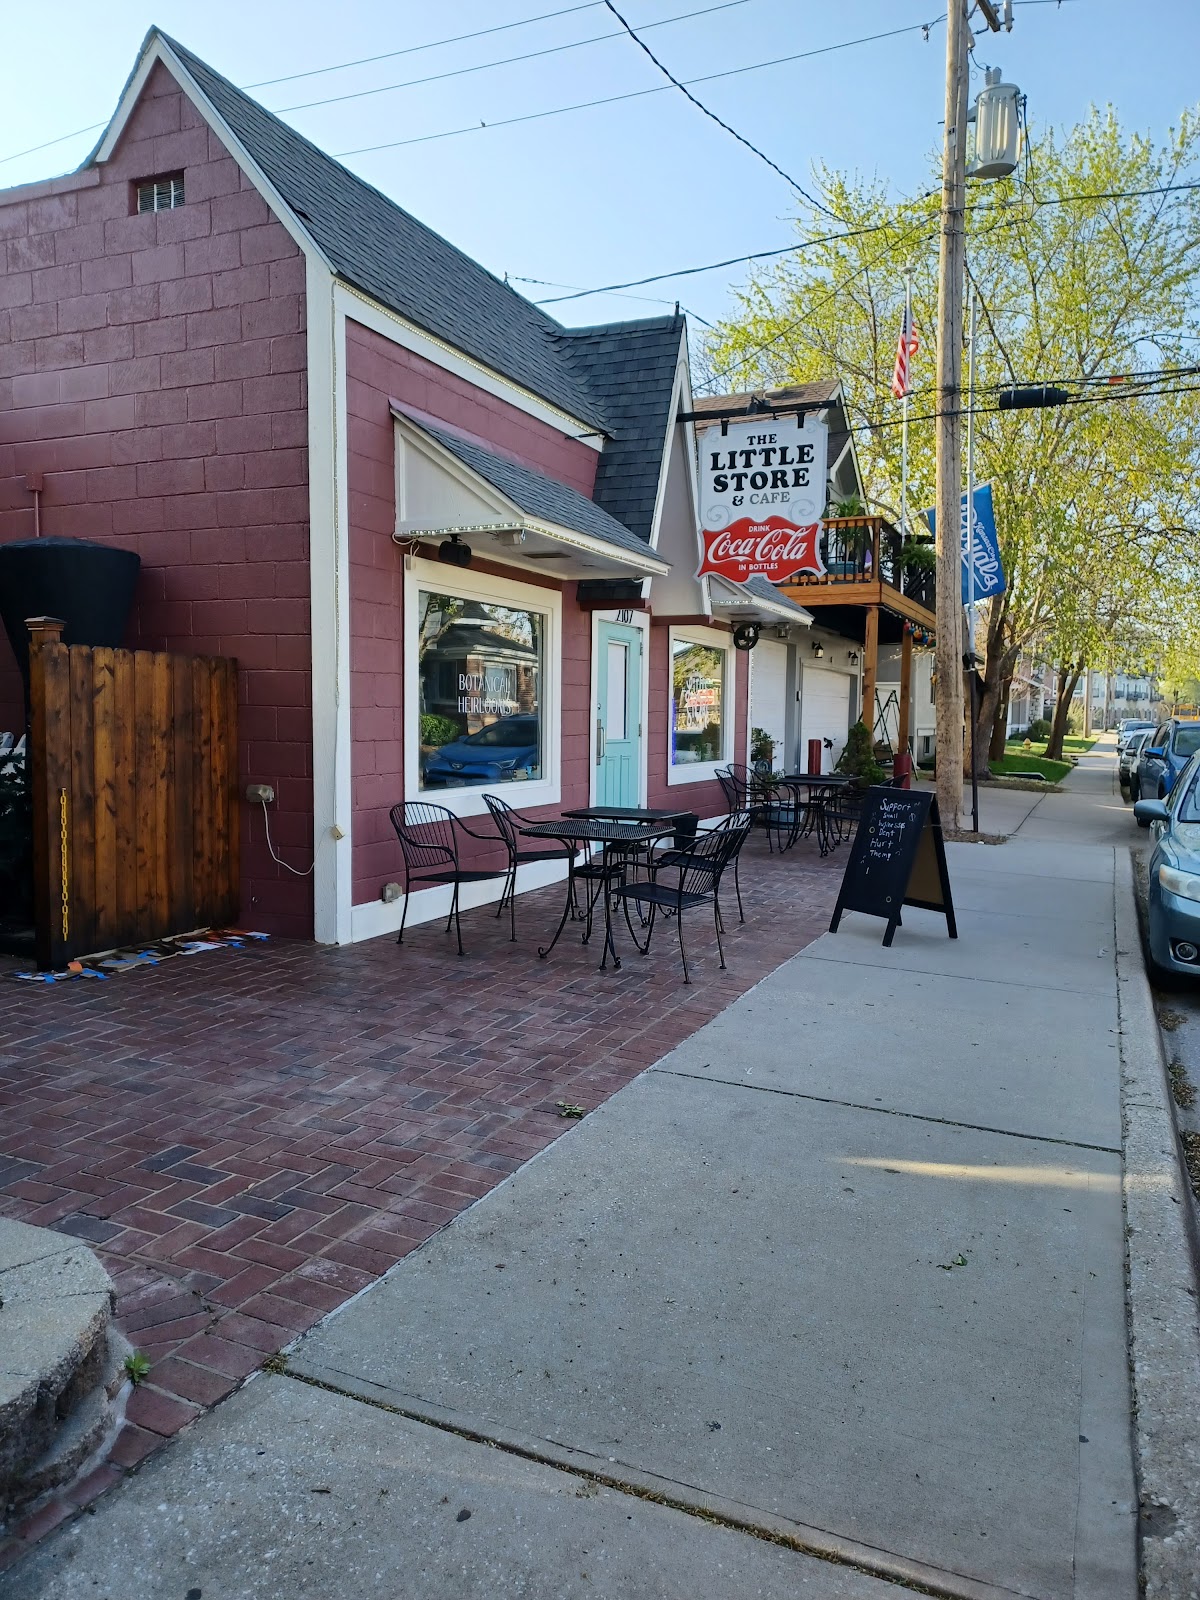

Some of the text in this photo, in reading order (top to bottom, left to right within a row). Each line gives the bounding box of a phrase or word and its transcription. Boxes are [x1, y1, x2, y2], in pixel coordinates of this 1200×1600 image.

[746, 433, 778, 446] THE
[710, 444, 815, 471] LITTLE
[713, 468, 810, 493] STORE
[732, 491, 791, 506] & CAFE
[748, 525, 770, 533] DRINK
[748, 562, 778, 571] BOTTLES
[615, 609, 634, 624] 2107
[458, 673, 509, 693] BOTANICAL
[880, 798, 911, 811] Support
[870, 838, 894, 849] Hurt
